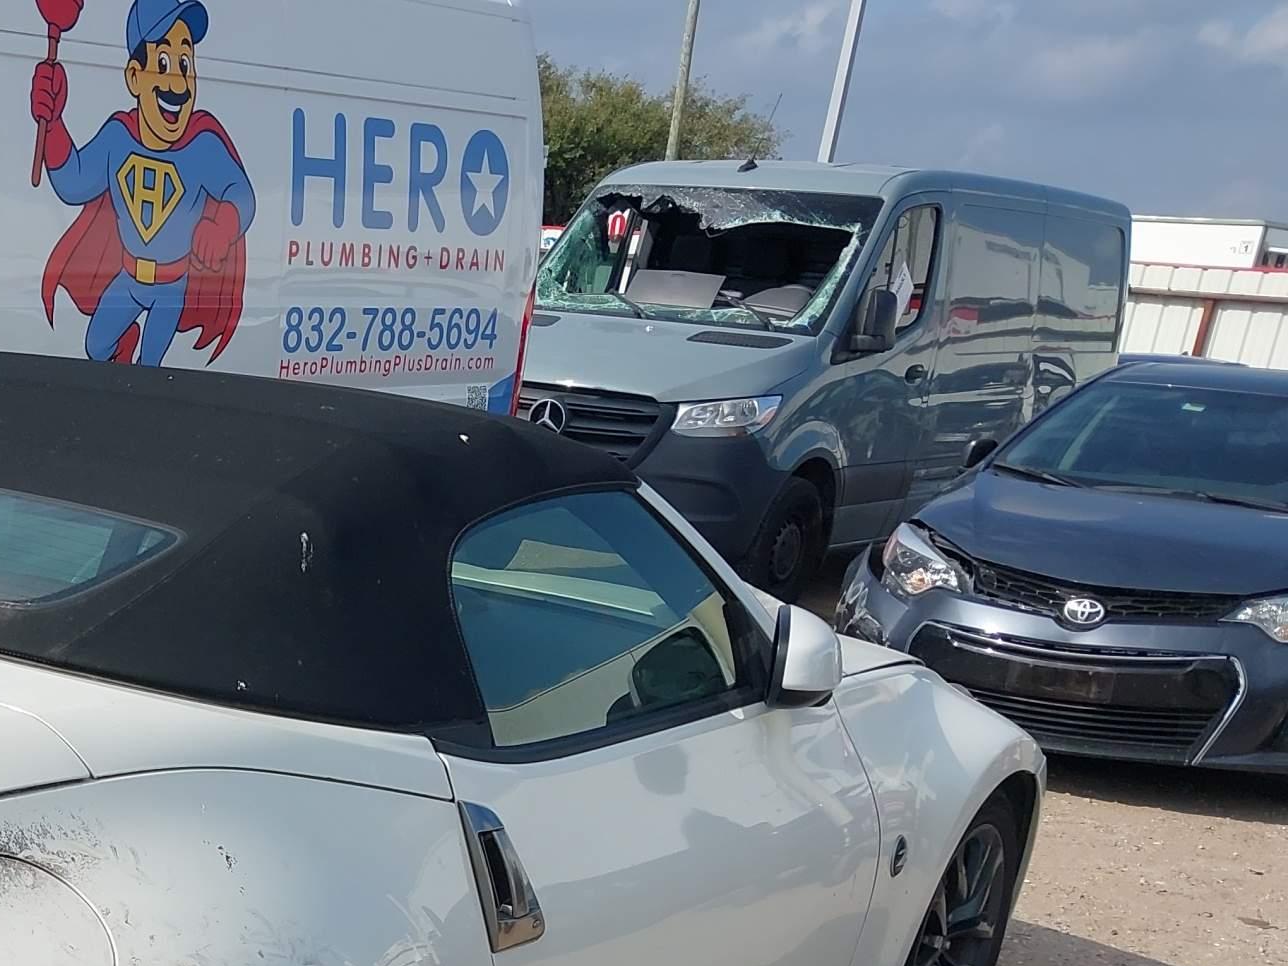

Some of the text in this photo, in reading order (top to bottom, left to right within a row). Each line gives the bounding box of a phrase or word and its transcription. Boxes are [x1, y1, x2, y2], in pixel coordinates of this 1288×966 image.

[290, 107, 510, 237] HERO
[287, 240, 505, 273] PLUMBING+DRAIN
[282, 306, 499, 353] 832-788-5694
[279, 353, 494, 379] HeroPlumbingPlusDrain.com
